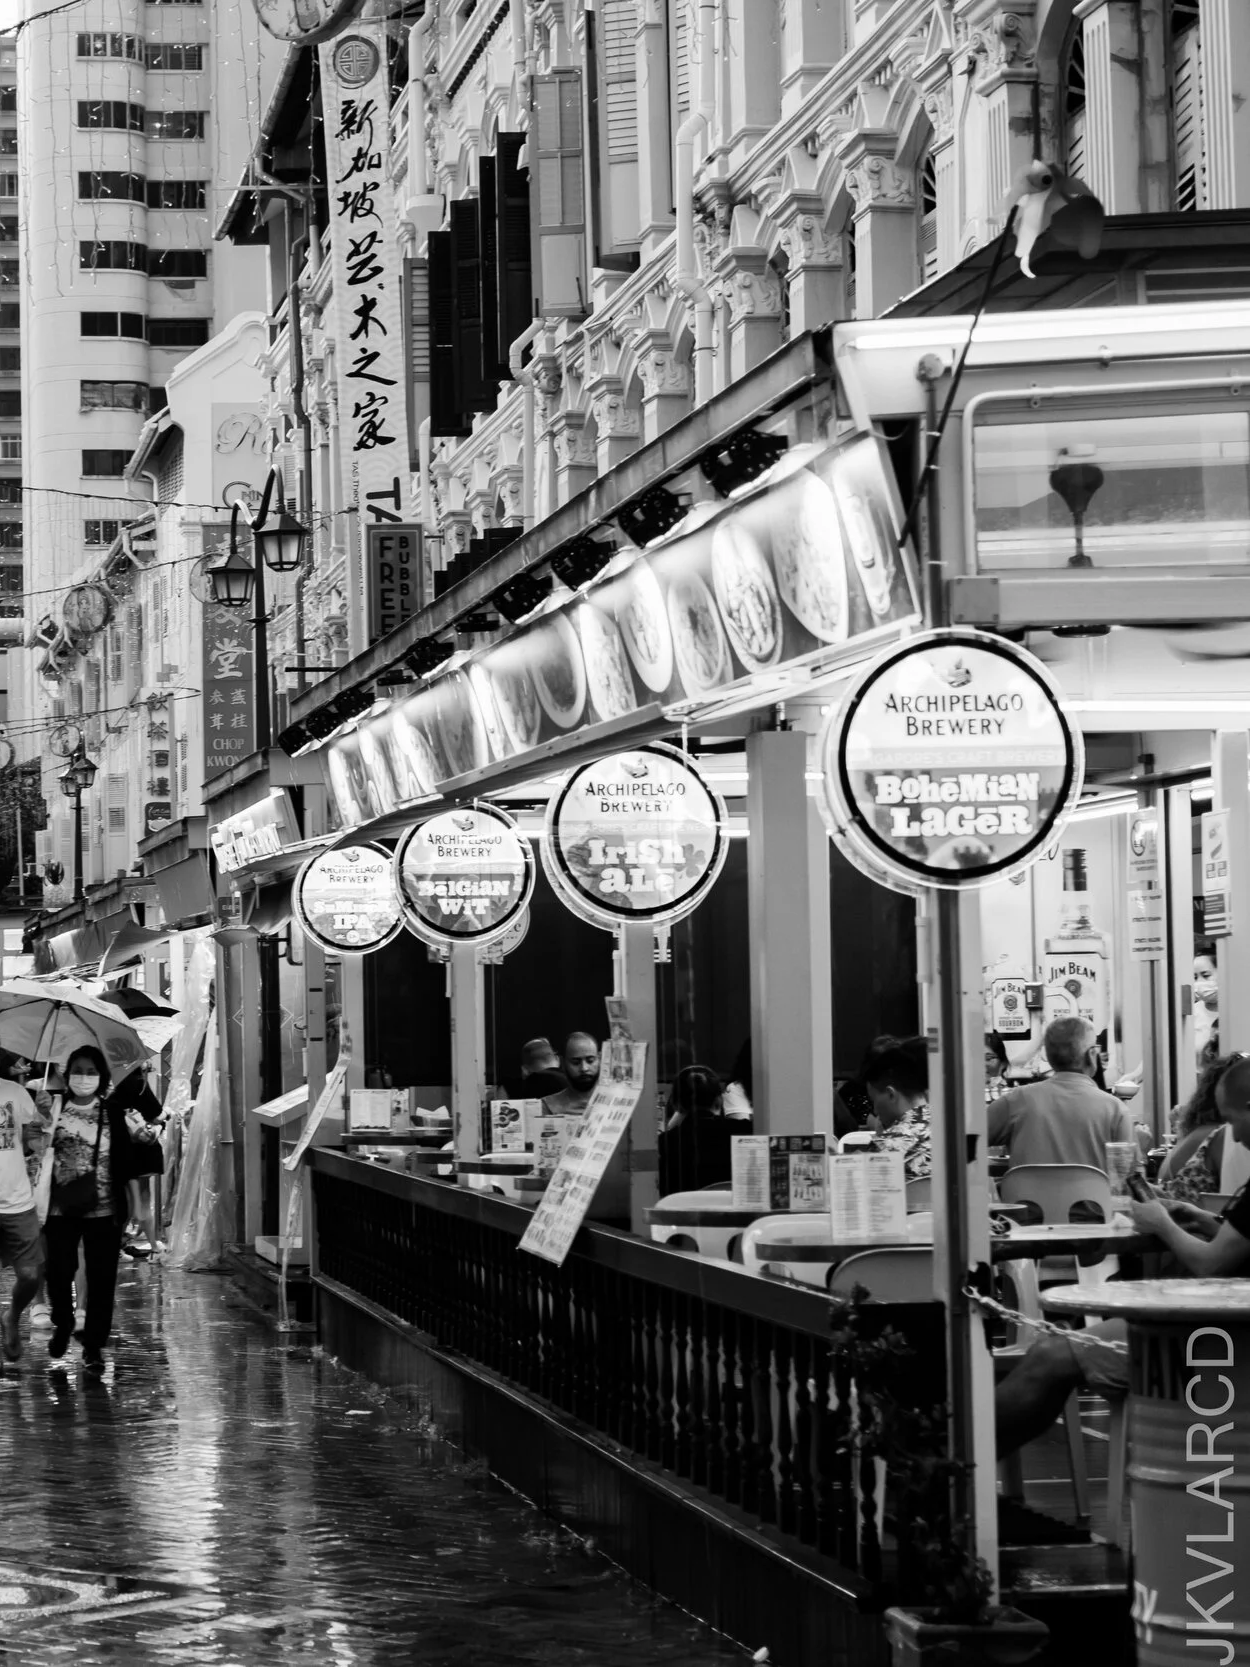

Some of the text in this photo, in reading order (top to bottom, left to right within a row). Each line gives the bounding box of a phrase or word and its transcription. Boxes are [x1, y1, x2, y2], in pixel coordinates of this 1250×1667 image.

[398, 536, 410, 622] BUBBL
[885, 692, 1024, 713] ARCHIPELAGO
[906, 715, 1006, 736] BREWERY
[213, 738, 245, 750] CHOP
[585, 781, 686, 796] ARCHIPELAGO
[600, 798, 672, 812] BREWERY
[428, 833, 502, 845] ARCHIPELAGO
[437, 846, 492, 857] BREWERY
[329, 874, 374, 884] BREWERY
[1048, 961, 1097, 984] JIM BEAM
